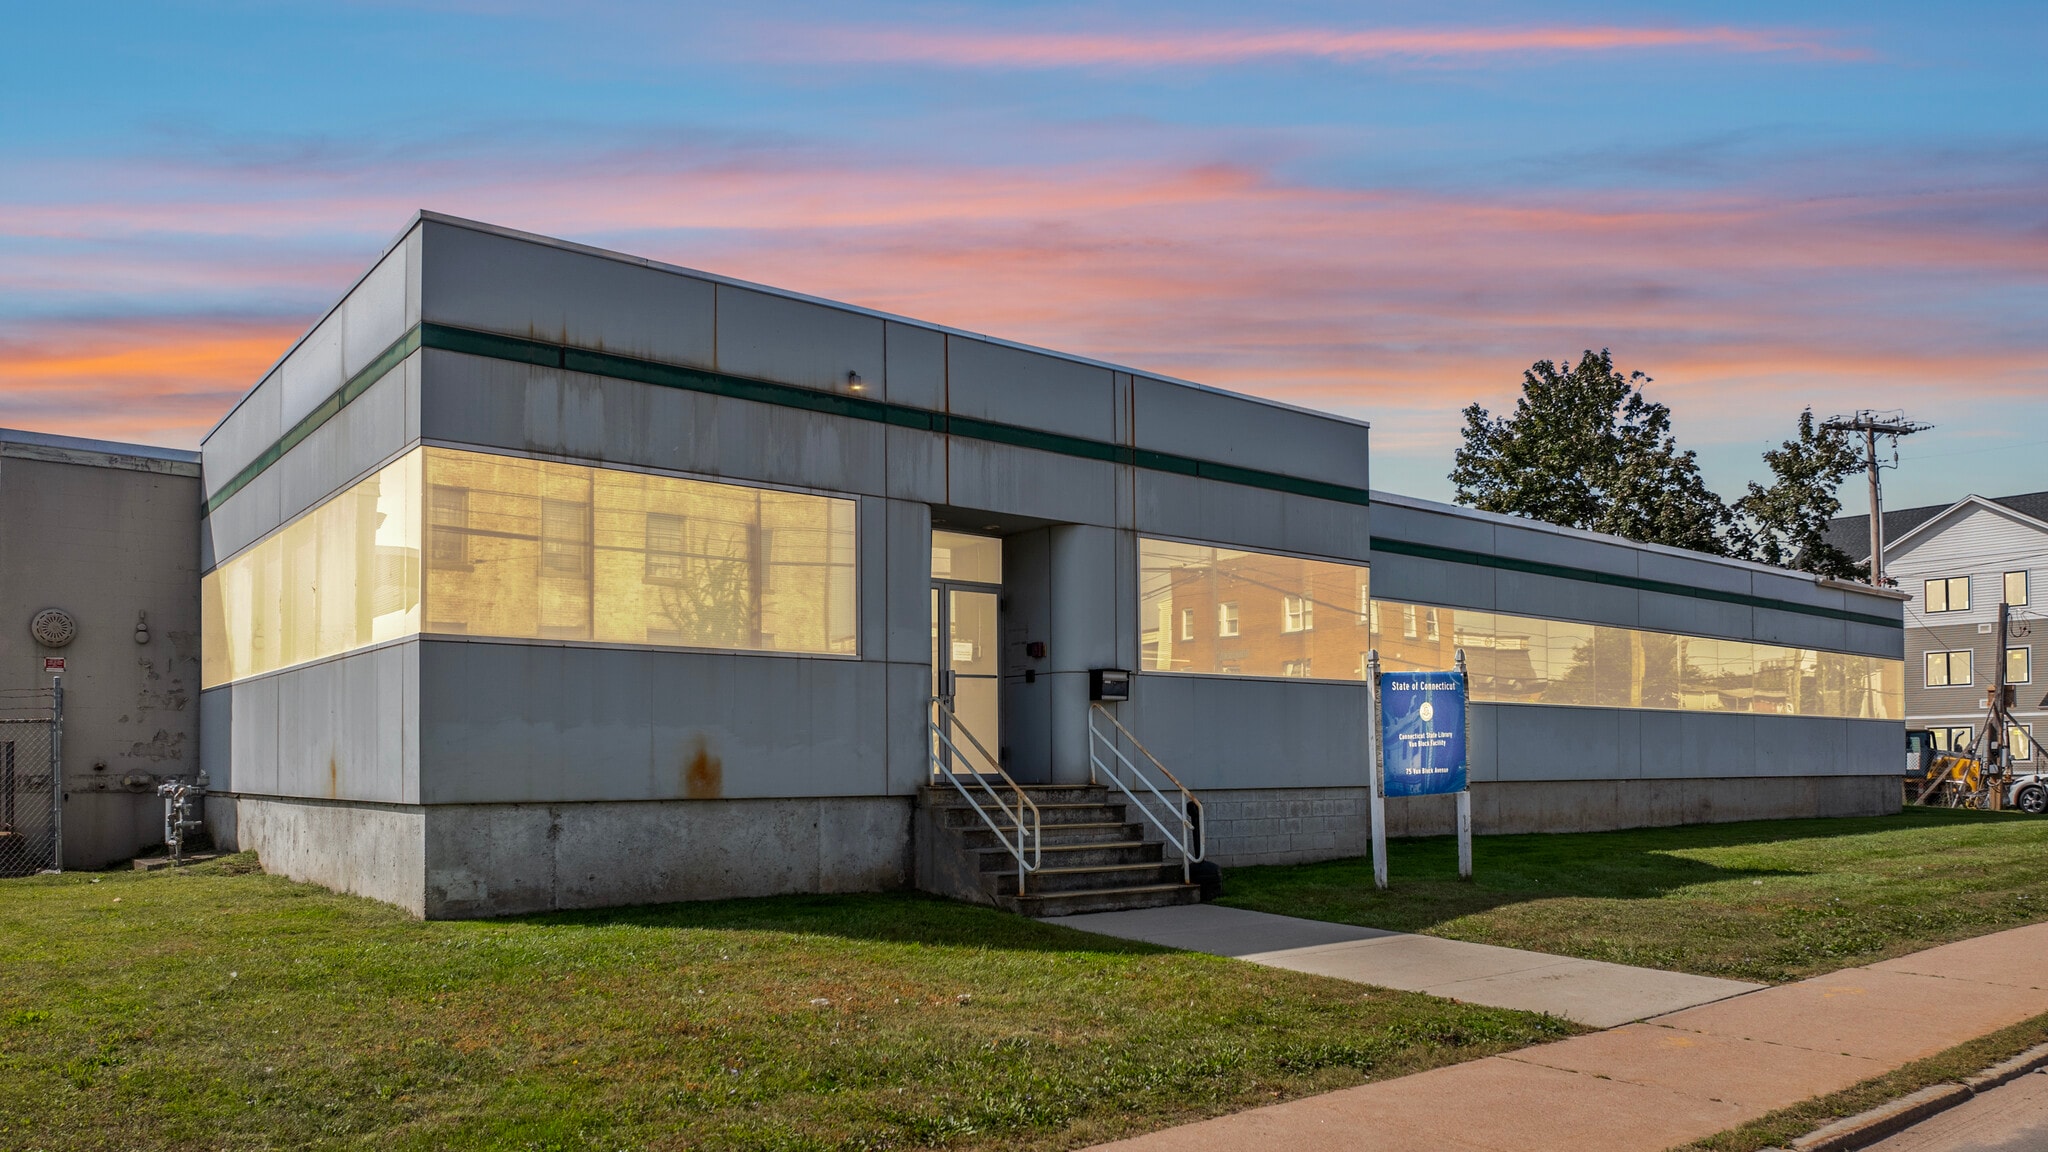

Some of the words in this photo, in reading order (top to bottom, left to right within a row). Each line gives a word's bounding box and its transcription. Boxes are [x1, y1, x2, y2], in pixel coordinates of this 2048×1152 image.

[1392, 682, 1410, 690] State
[1412, 682, 1418, 690] of
[1420, 682, 1456, 690] Connecticut
